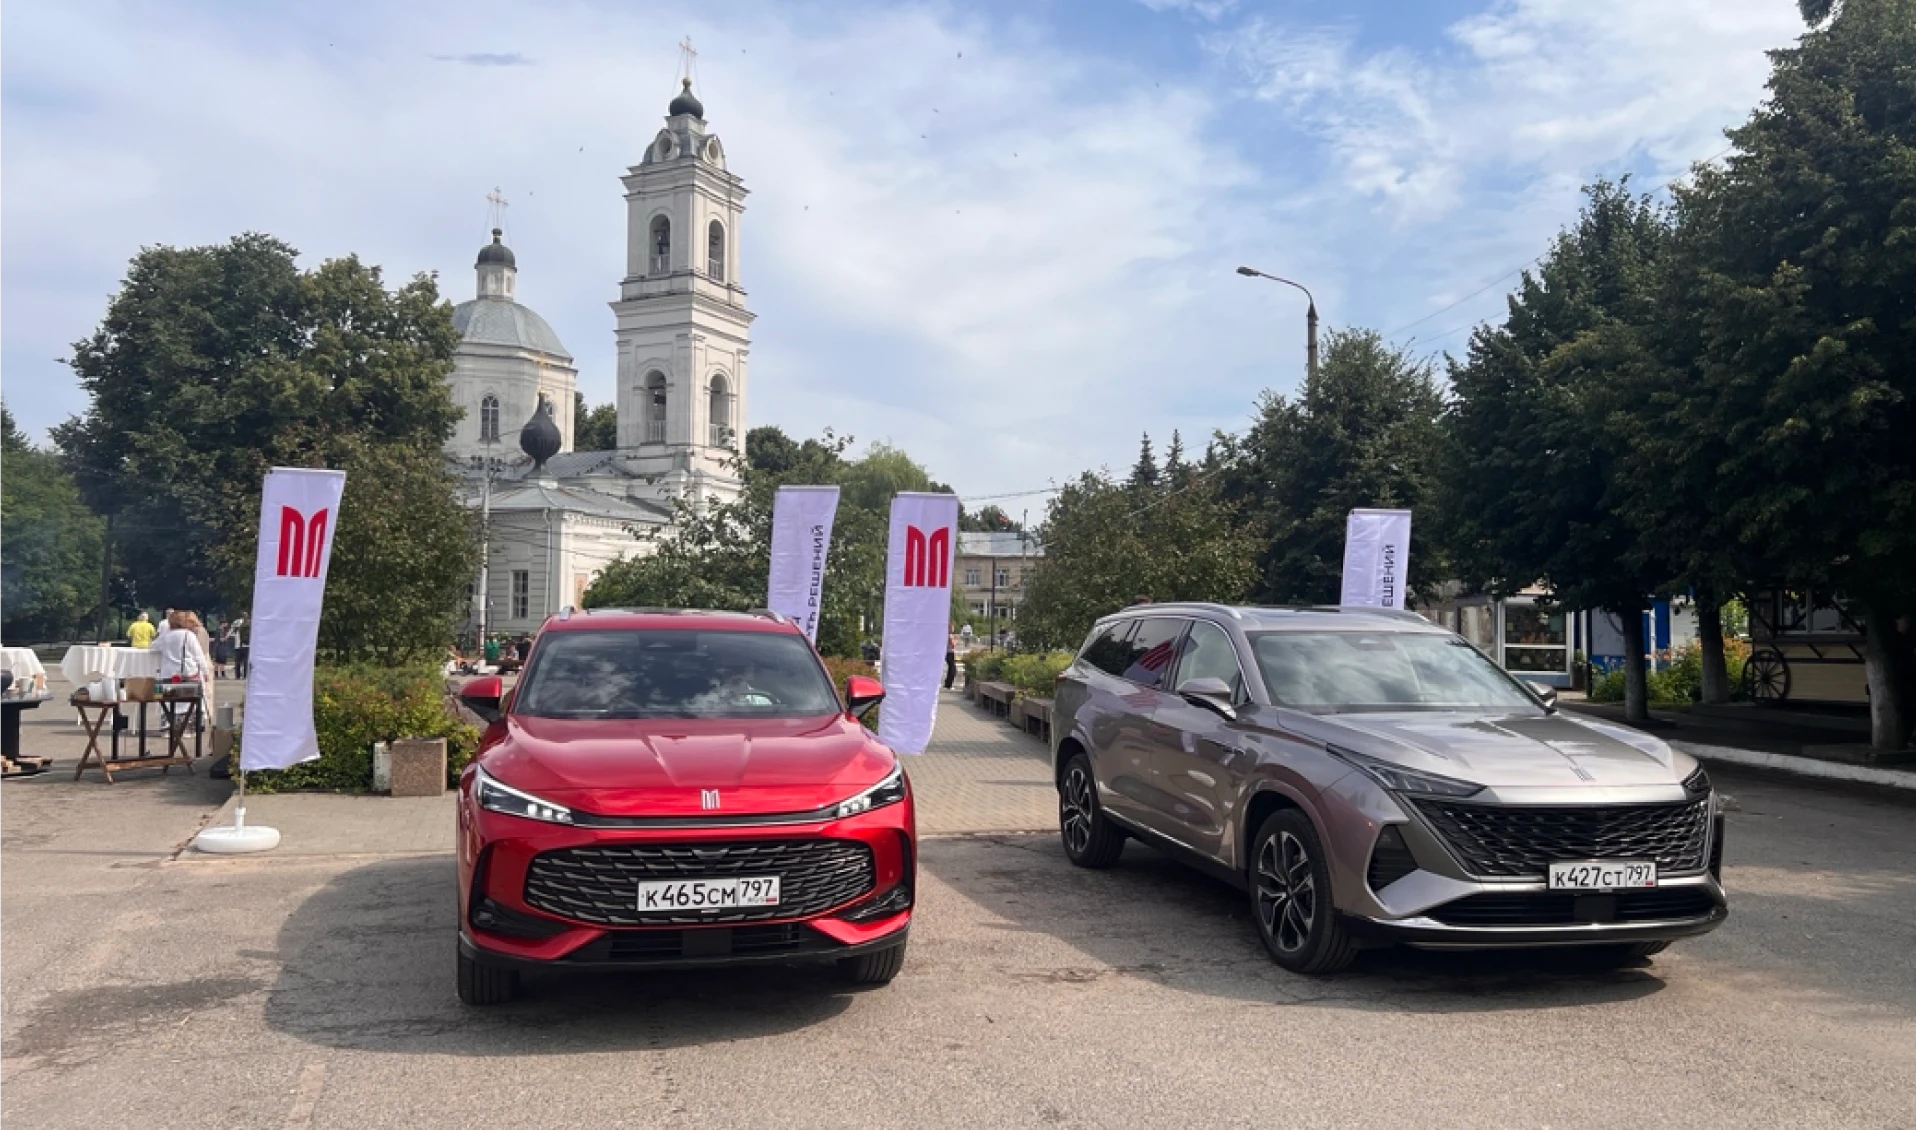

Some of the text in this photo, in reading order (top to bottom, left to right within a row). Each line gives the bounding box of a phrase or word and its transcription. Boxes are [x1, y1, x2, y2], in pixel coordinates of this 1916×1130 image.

[808, 525, 823, 607] РЕШЕНИЙ
[1382, 544, 1395, 607] ЕШЕНИЙ
[645, 879, 774, 907] К465СМ 797
[1554, 865, 1652, 887] К427СТ 797
